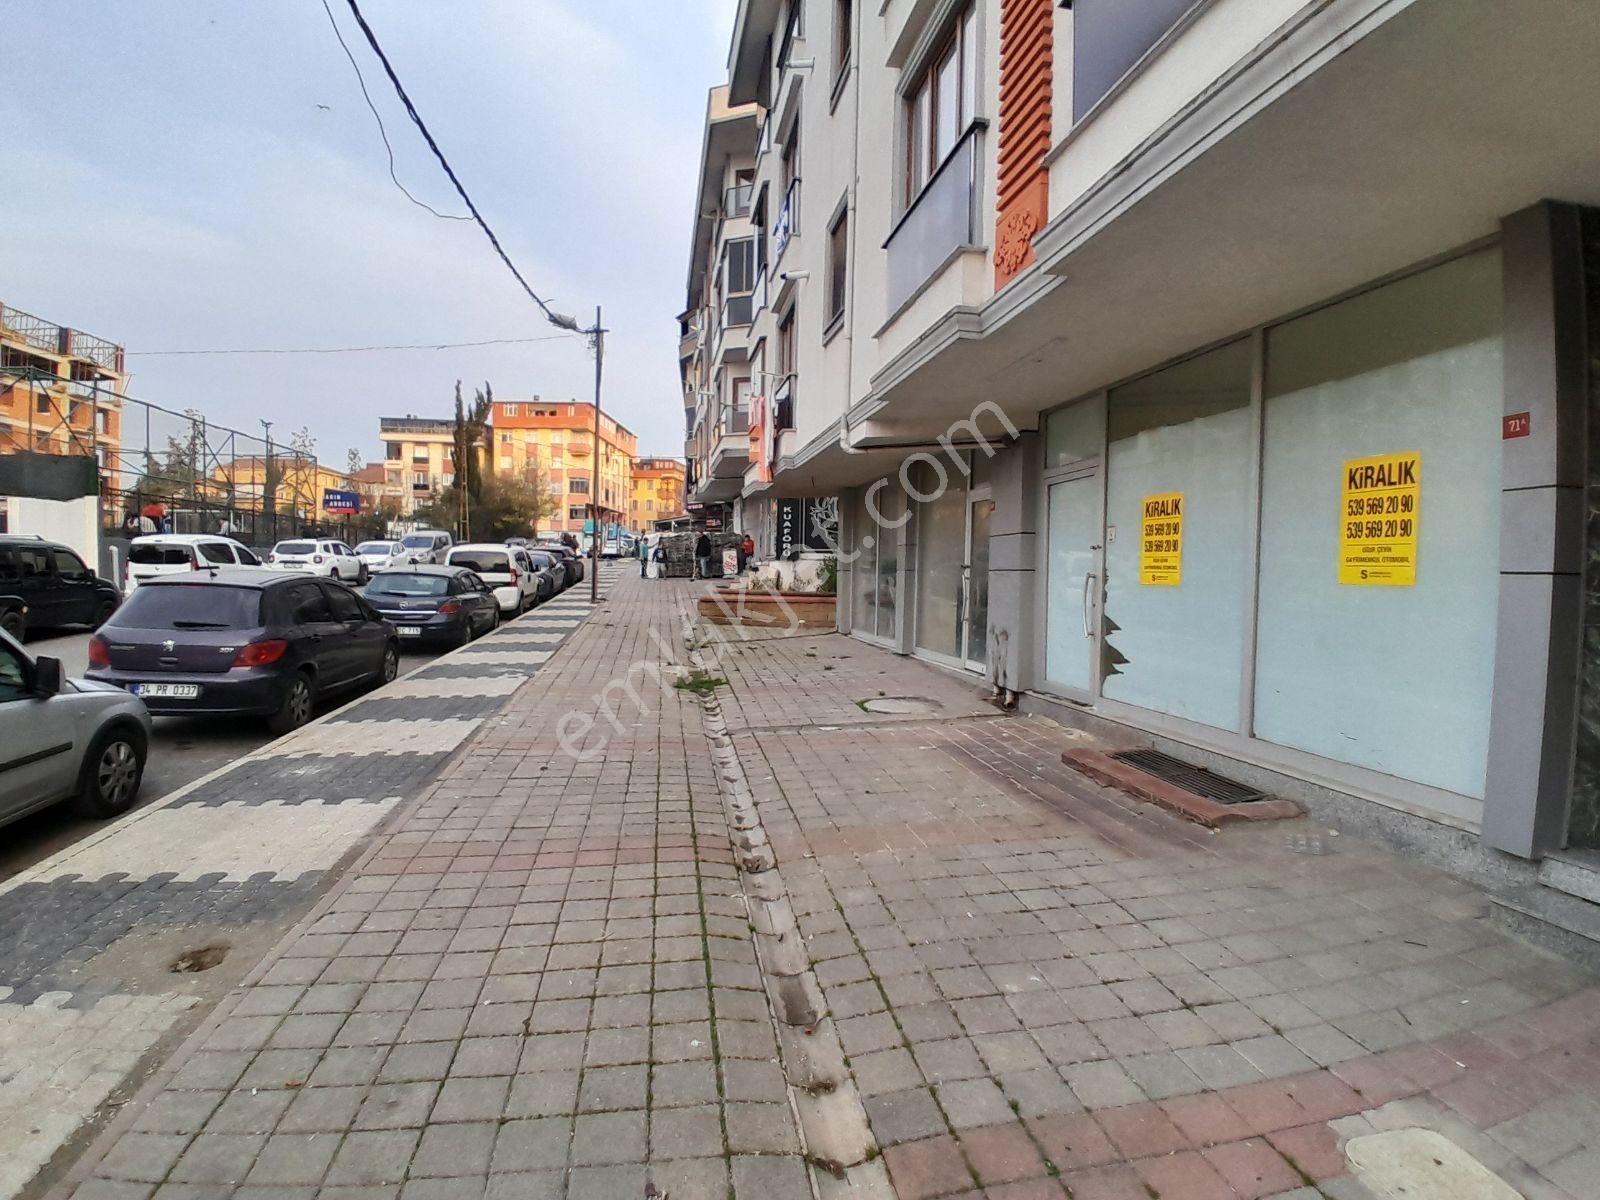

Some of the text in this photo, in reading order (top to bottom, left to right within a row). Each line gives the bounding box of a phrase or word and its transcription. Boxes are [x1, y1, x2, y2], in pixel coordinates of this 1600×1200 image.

[1347, 495, 1413, 516] 539 569 20 90
[1145, 524, 1154, 536] 539
[1165, 523, 1172, 536] 20
[1172, 522, 1180, 535] 90
[1346, 519, 1412, 539] 539 569 20 90
[139, 685, 197, 695] 34 PR 0337
